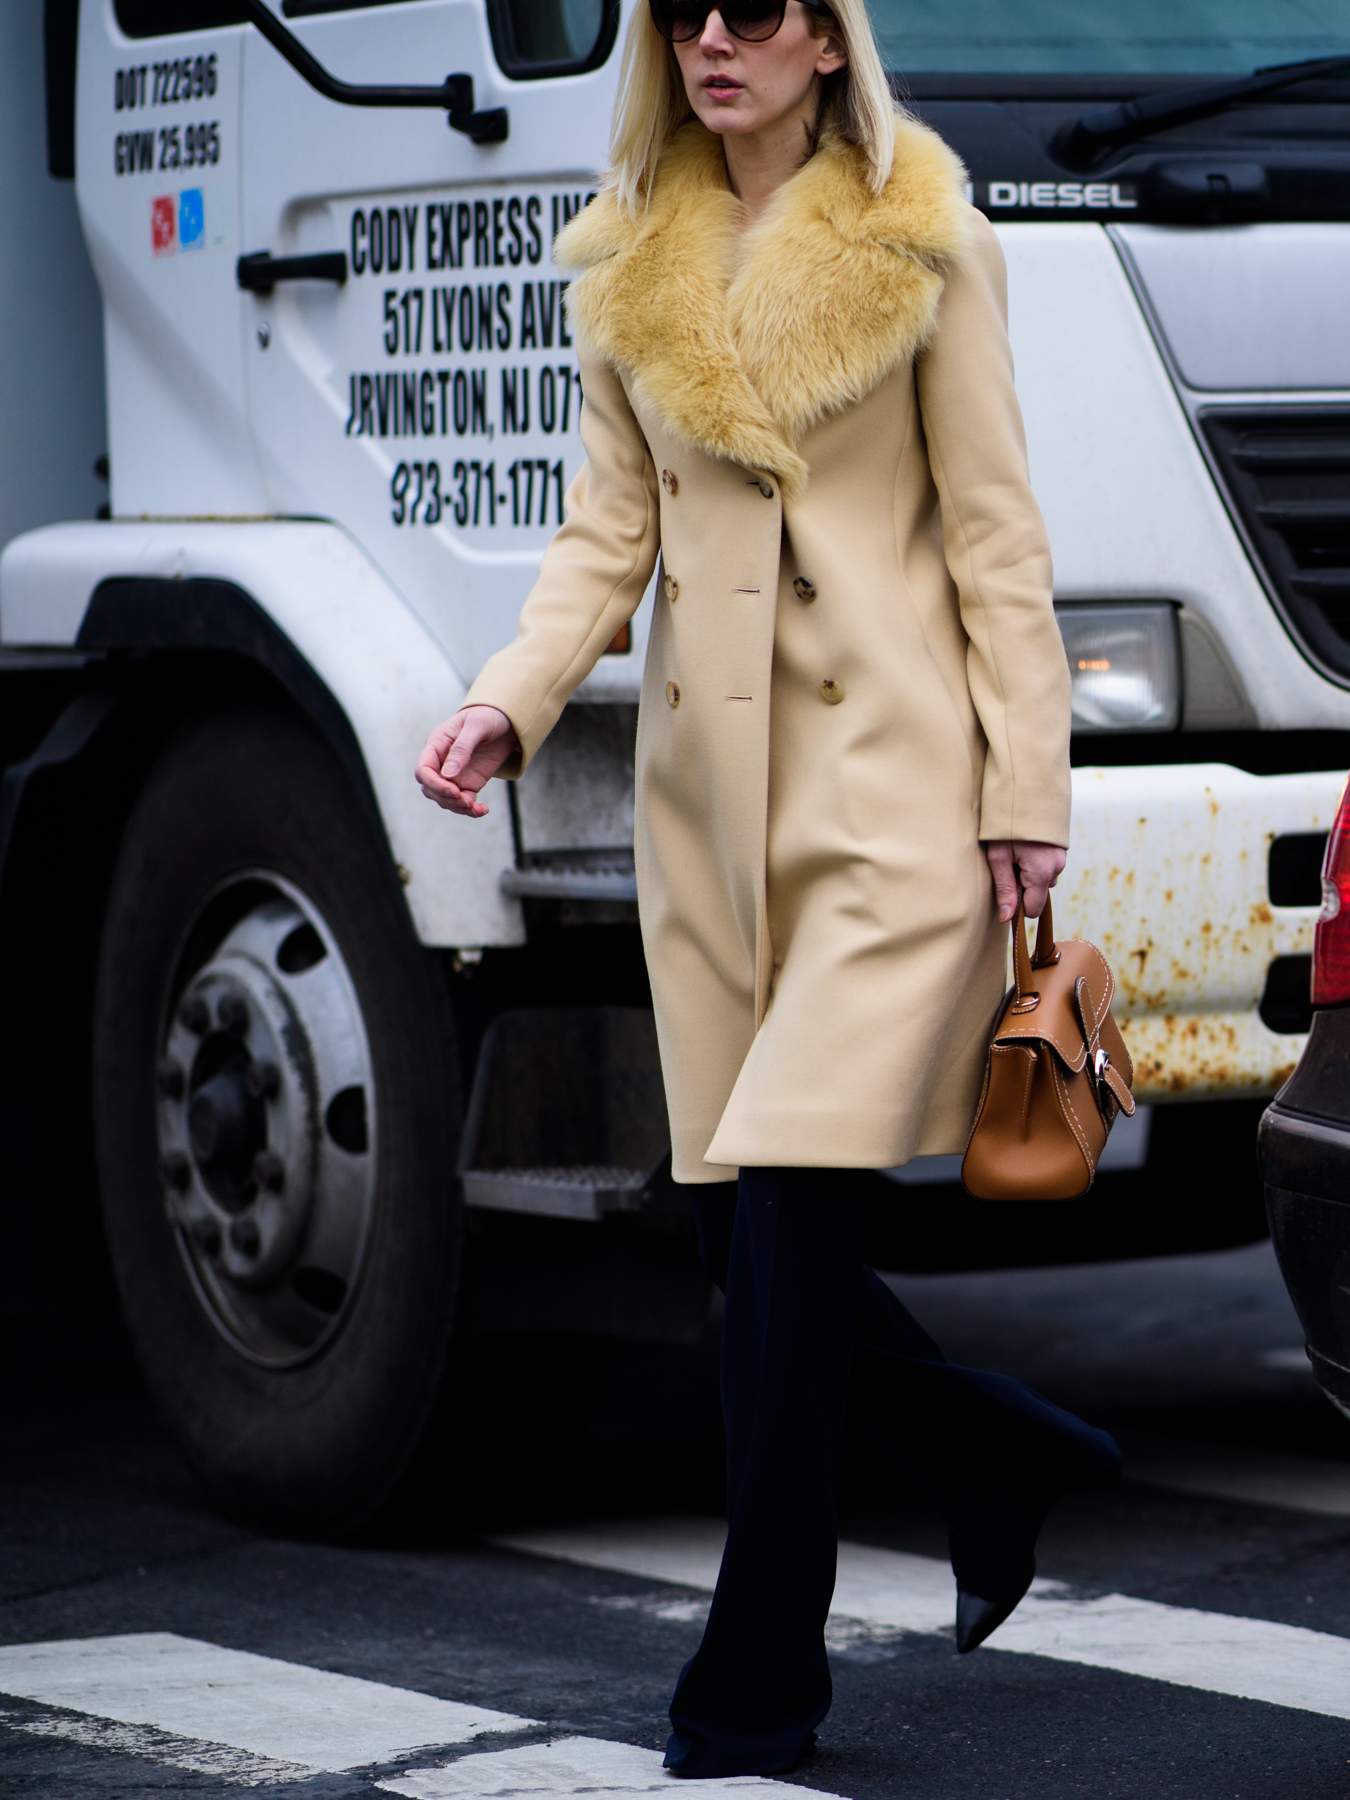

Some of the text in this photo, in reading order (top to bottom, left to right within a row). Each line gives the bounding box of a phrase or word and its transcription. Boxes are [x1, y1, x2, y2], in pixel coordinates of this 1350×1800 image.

[115, 53, 217, 112] DOT 722596
[115, 130, 155, 176] GVW
[988, 182, 1138, 208] DIESEL
[351, 205, 419, 276] CODY
[426, 195, 542, 270] EXPRESS
[383, 288, 425, 356] 517
[432, 282, 512, 353] LYONS
[502, 367, 529, 434] NJ
